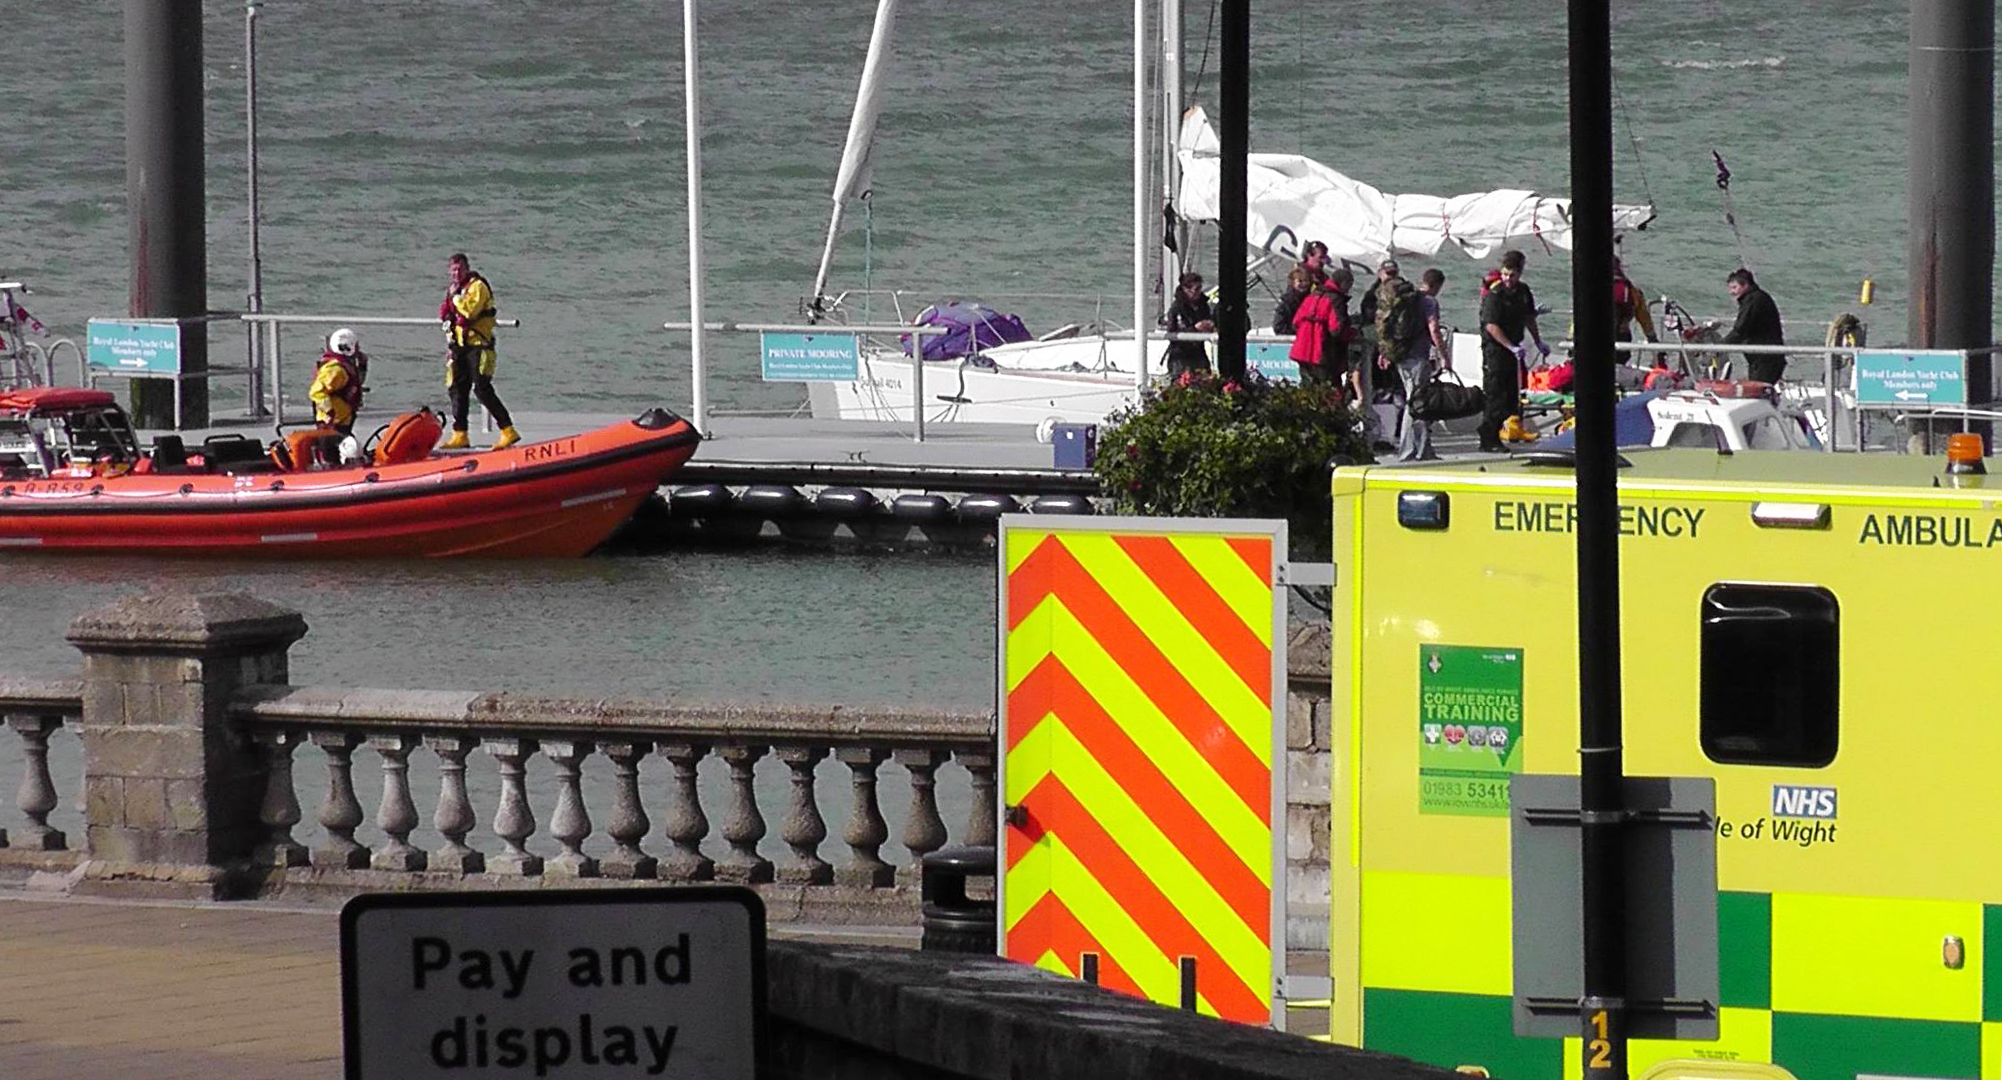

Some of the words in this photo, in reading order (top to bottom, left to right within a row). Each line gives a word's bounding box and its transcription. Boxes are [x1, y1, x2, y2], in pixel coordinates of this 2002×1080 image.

[768, 348, 804, 359] PRIVATE
[807, 349, 852, 360] MOORING
[1861, 369, 1885, 380] Royal
[1886, 369, 1916, 379] London
[1917, 370, 1938, 380] Yacht
[1940, 370, 1959, 380] Club
[1883, 380, 1920, 390] Members
[1921, 380, 1937, 391] only
[524, 440, 576, 461] RNLI
[1494, 501, 1705, 537] EMERENCY
[1424, 692, 1519, 708] COMMERCIAL
[1423, 704, 1519, 722] TRAINING
[1423, 781, 1462, 796] 01983
[1774, 787, 1836, 816] NHS
[1741, 818, 1766, 839] of
[1772, 819, 1837, 847] Wight
[412, 936, 535, 999] Pay
[567, 932, 692, 988] and
[430, 1013, 679, 1077] display
